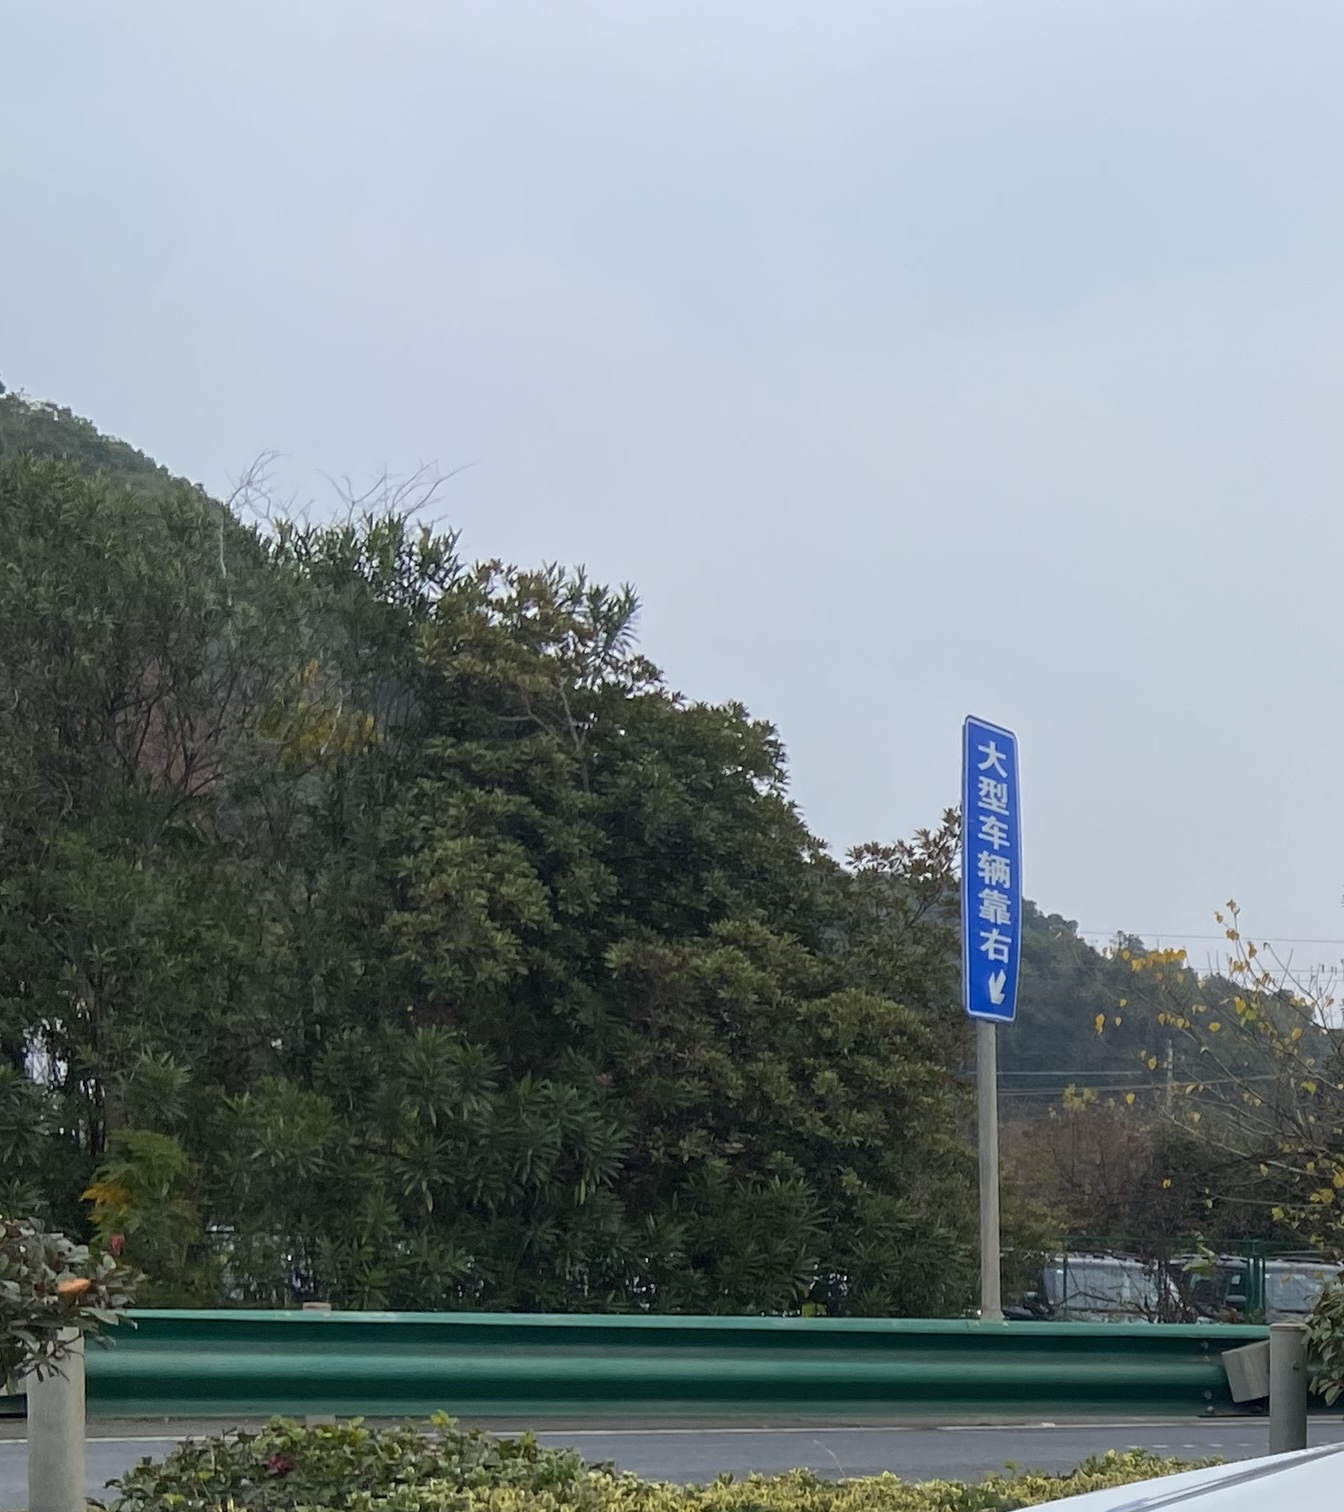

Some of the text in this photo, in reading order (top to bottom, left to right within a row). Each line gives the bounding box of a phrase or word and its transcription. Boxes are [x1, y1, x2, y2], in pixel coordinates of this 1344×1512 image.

[977, 741, 1013, 965] 大型车辆靠右
